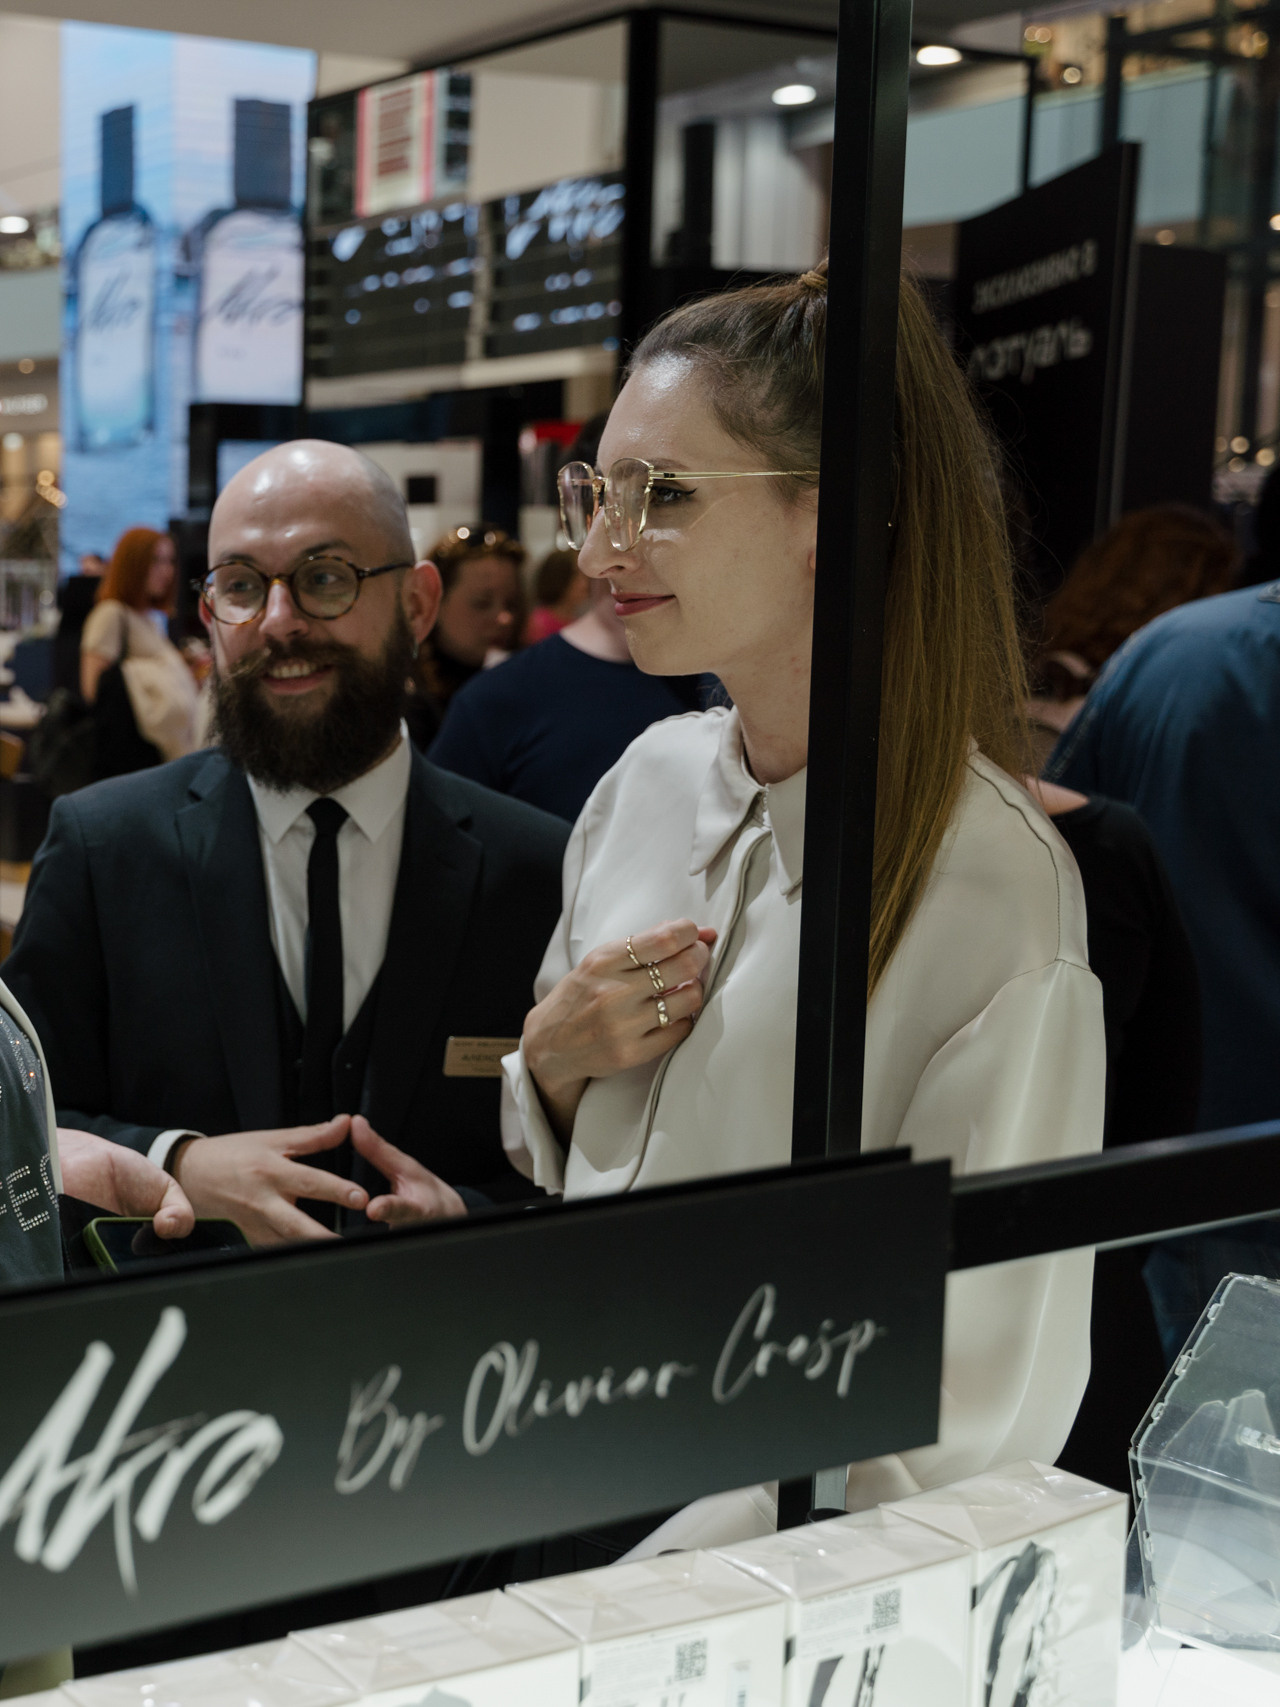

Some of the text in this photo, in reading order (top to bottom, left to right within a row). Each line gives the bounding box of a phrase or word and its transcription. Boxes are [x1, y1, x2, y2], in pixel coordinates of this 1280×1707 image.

[334, 1283, 888, 1495] By Olivier Cresp
